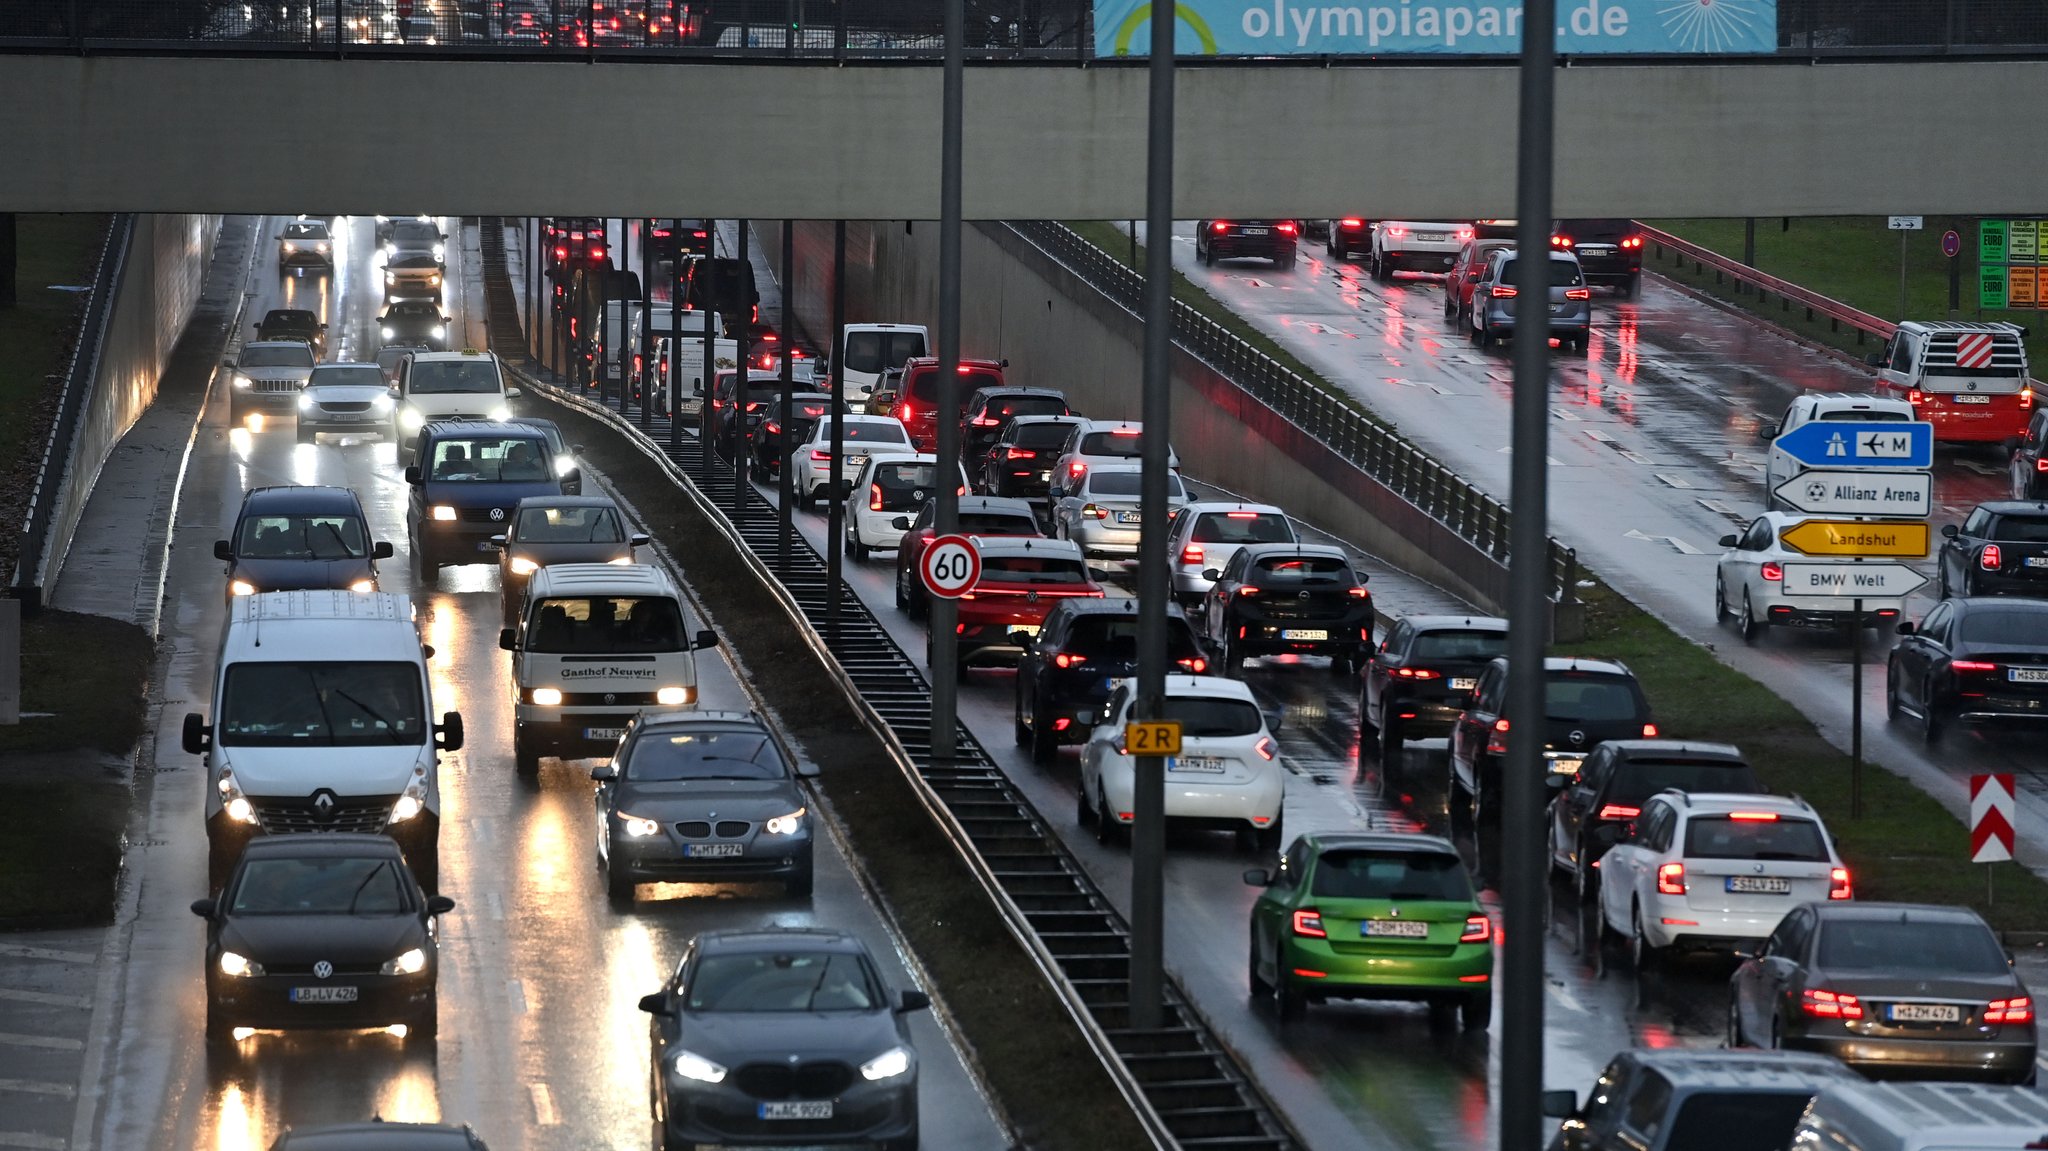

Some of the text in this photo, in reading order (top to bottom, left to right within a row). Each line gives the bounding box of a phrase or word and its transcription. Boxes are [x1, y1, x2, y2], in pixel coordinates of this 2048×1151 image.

[1242, 0, 1628, 46] olympiapar.de
[1984, 235, 2003, 246] EURO
[1984, 282, 2003, 292] EURO
[1893, 438, 1906, 452] M
[1834, 486, 1920, 502] Allianz Arena
[1830, 532, 1896, 547] Landshut
[934, 553, 967, 581] 60
[1810, 574, 1885, 587] BMW Welt
[561, 667, 656, 678] Gasthof Neuwirt
[1136, 728, 1170, 748] 2 R
[690, 845, 742, 855] M MT 1274
[296, 988, 357, 999] LB LV 426
[1897, 1007, 1954, 1019] M ZM 476
